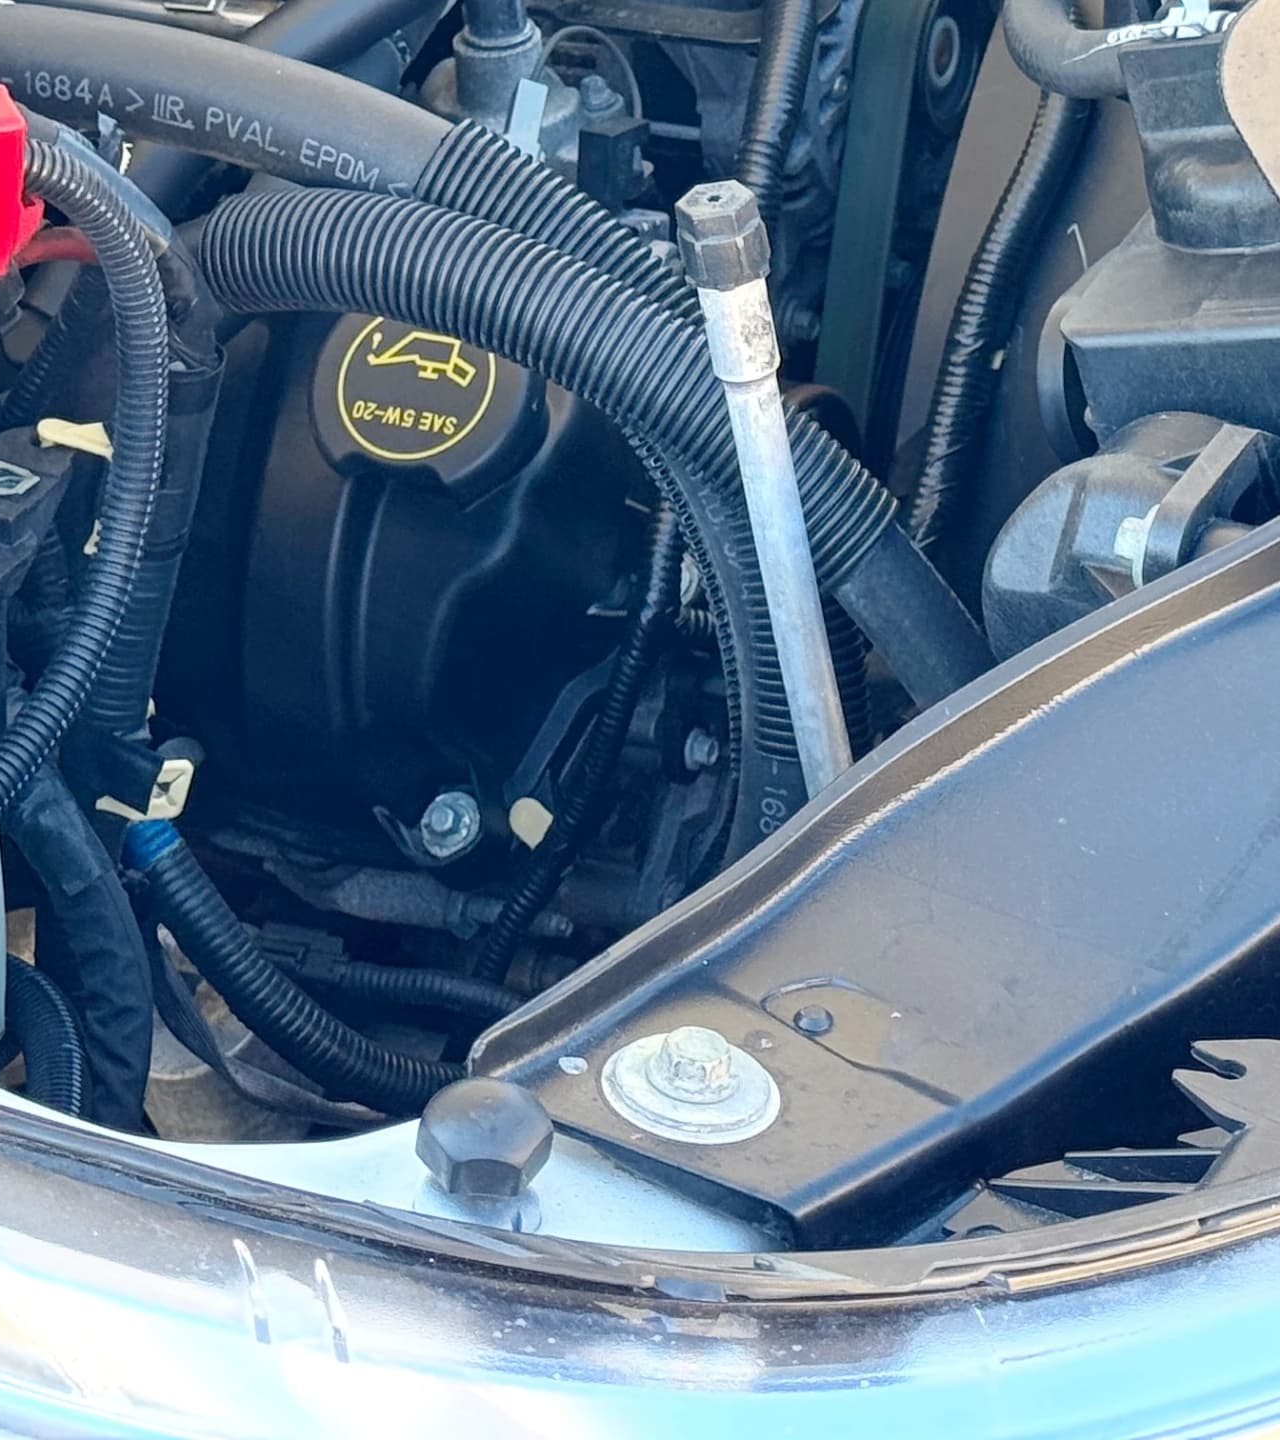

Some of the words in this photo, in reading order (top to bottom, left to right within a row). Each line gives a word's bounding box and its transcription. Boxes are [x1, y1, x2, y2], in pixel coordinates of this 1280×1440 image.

[23, 70, 114, 109] 1684A
[298, 137, 380, 192] EPDM
[351, 400, 417, 428] 5W-20
[418, 411, 458, 435] SAE
